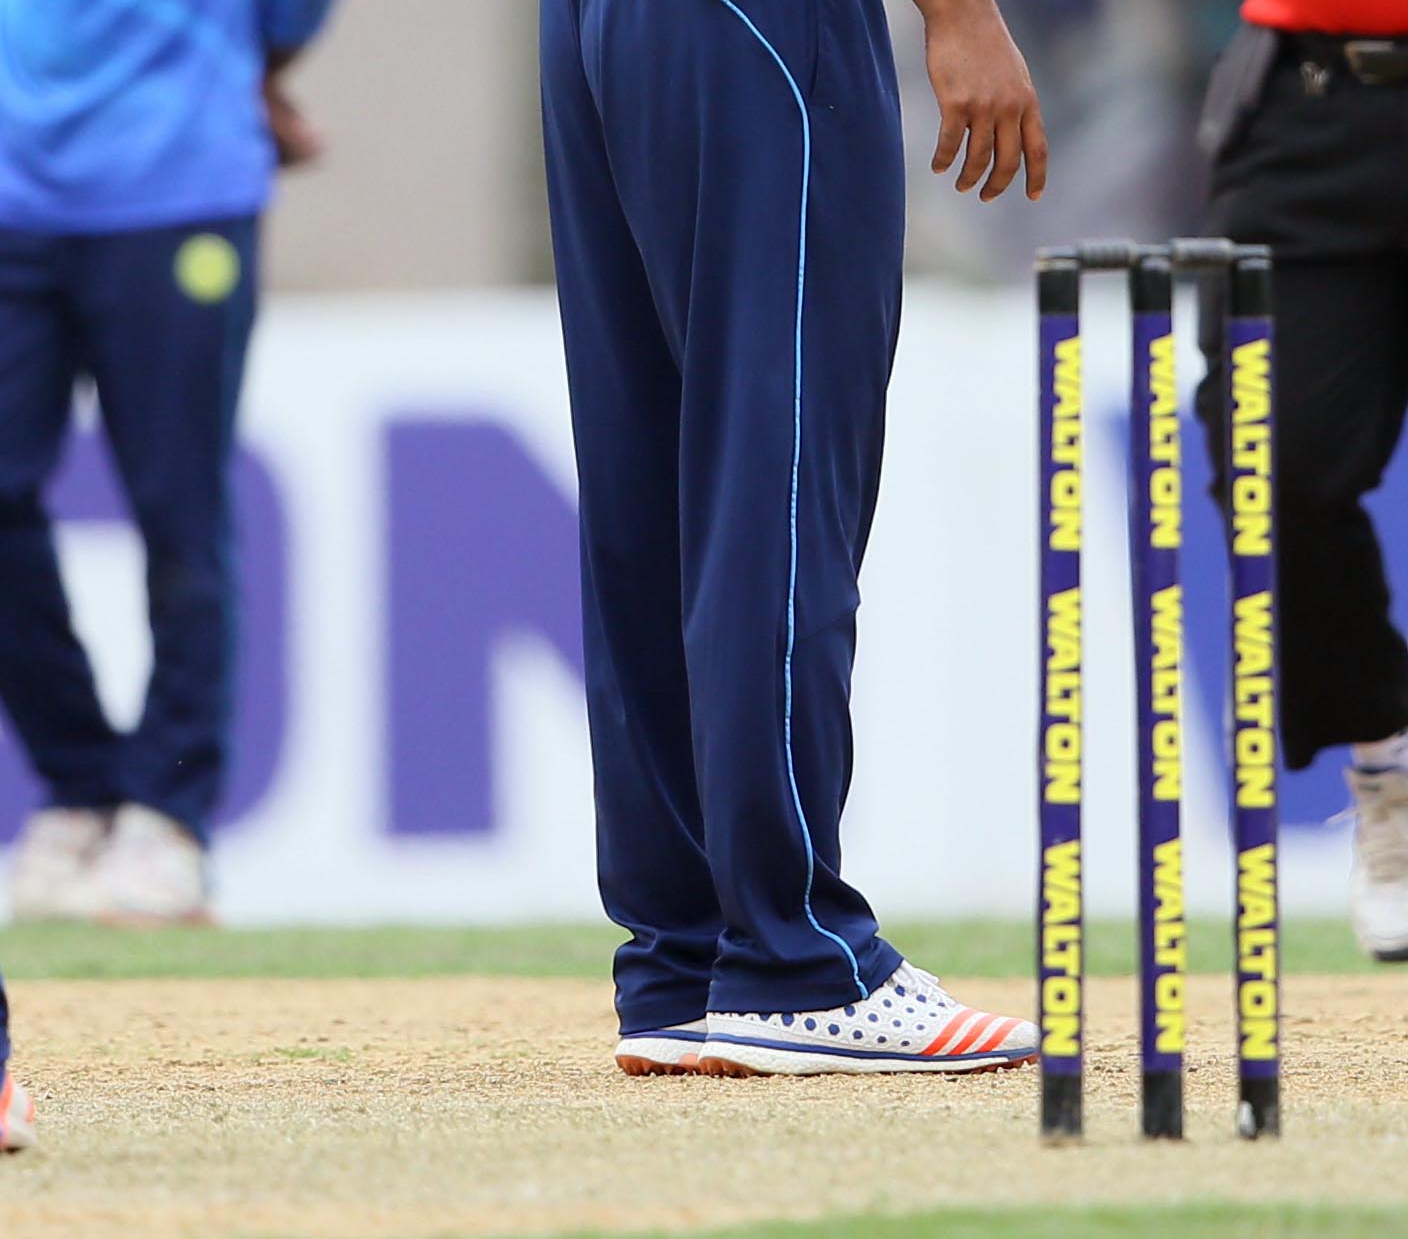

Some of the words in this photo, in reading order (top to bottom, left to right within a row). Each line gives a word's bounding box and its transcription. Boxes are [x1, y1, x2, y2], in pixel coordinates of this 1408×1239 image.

[1050, 337, 1083, 551] WALTON
[1148, 333, 1182, 549] WALTON
[1231, 340, 1272, 556] WALTON
[1045, 589, 1083, 804] WALTON
[1149, 585, 1184, 801] WALTON
[1234, 592, 1275, 808] WALTON
[1041, 841, 1082, 1056] WALTON
[1152, 837, 1189, 1055] WALTON
[1238, 845, 1280, 1060] WALTON
